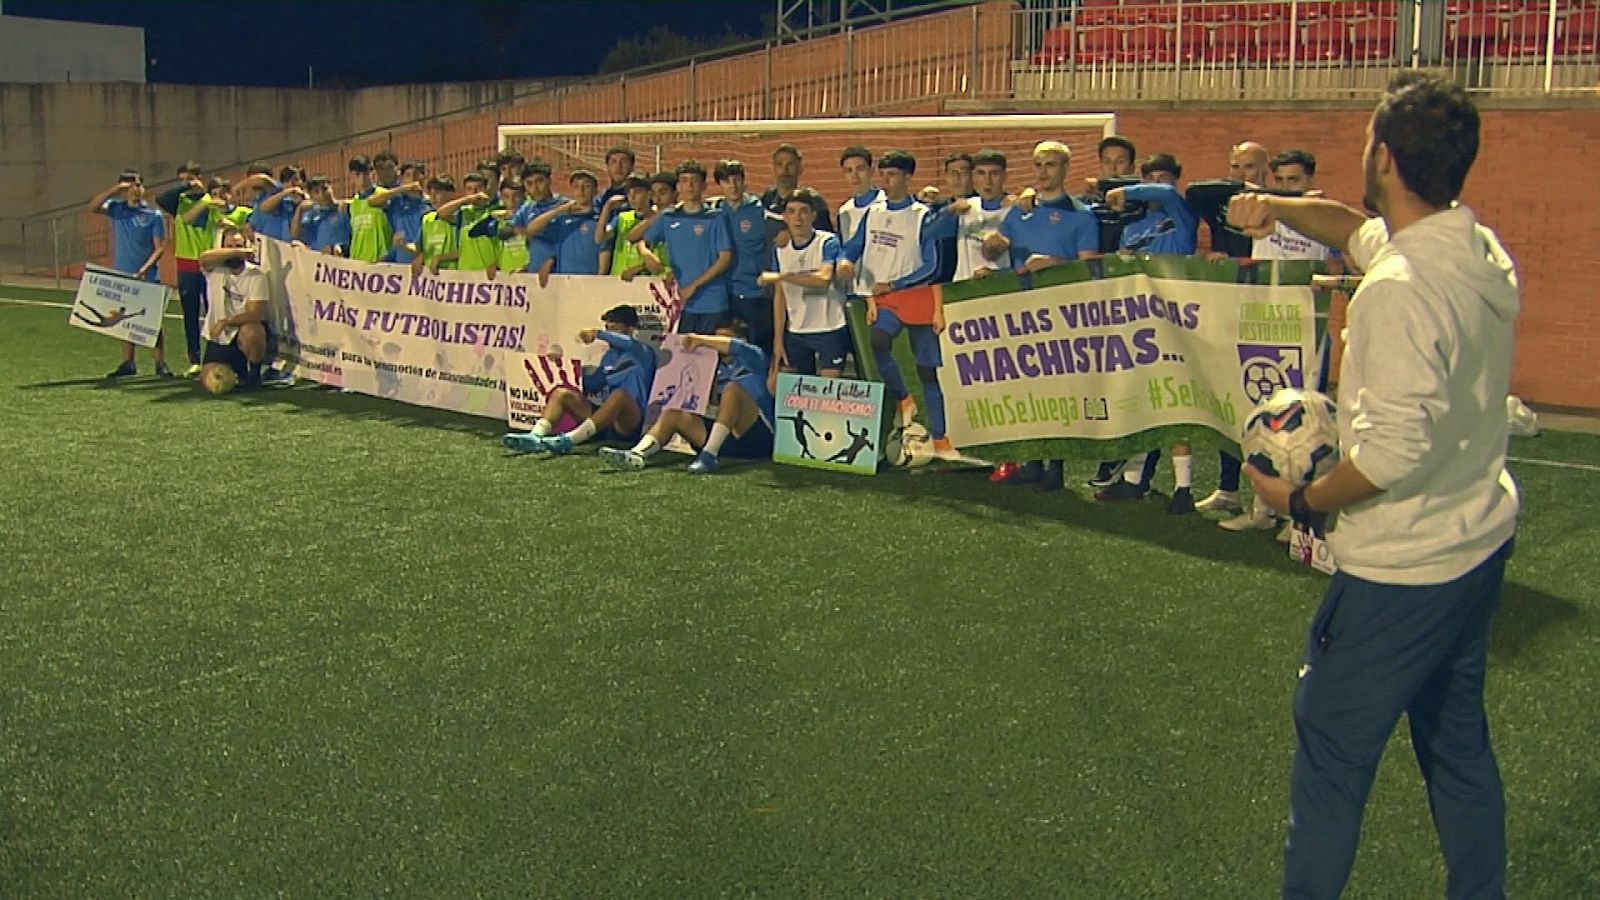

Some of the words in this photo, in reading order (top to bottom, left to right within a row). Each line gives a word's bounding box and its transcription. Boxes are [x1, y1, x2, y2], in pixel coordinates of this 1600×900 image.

[314, 262, 402, 295] ¡MENOS
[407, 276, 531, 313] MACHISTAS,
[362, 309, 526, 350] FUTBOLISTAS!
[949, 315, 1000, 345] CON
[1004, 308, 1053, 336] LAS
[955, 328, 1185, 386] MACHISTAS...
[965, 392, 1079, 430] #NoSeJuega
